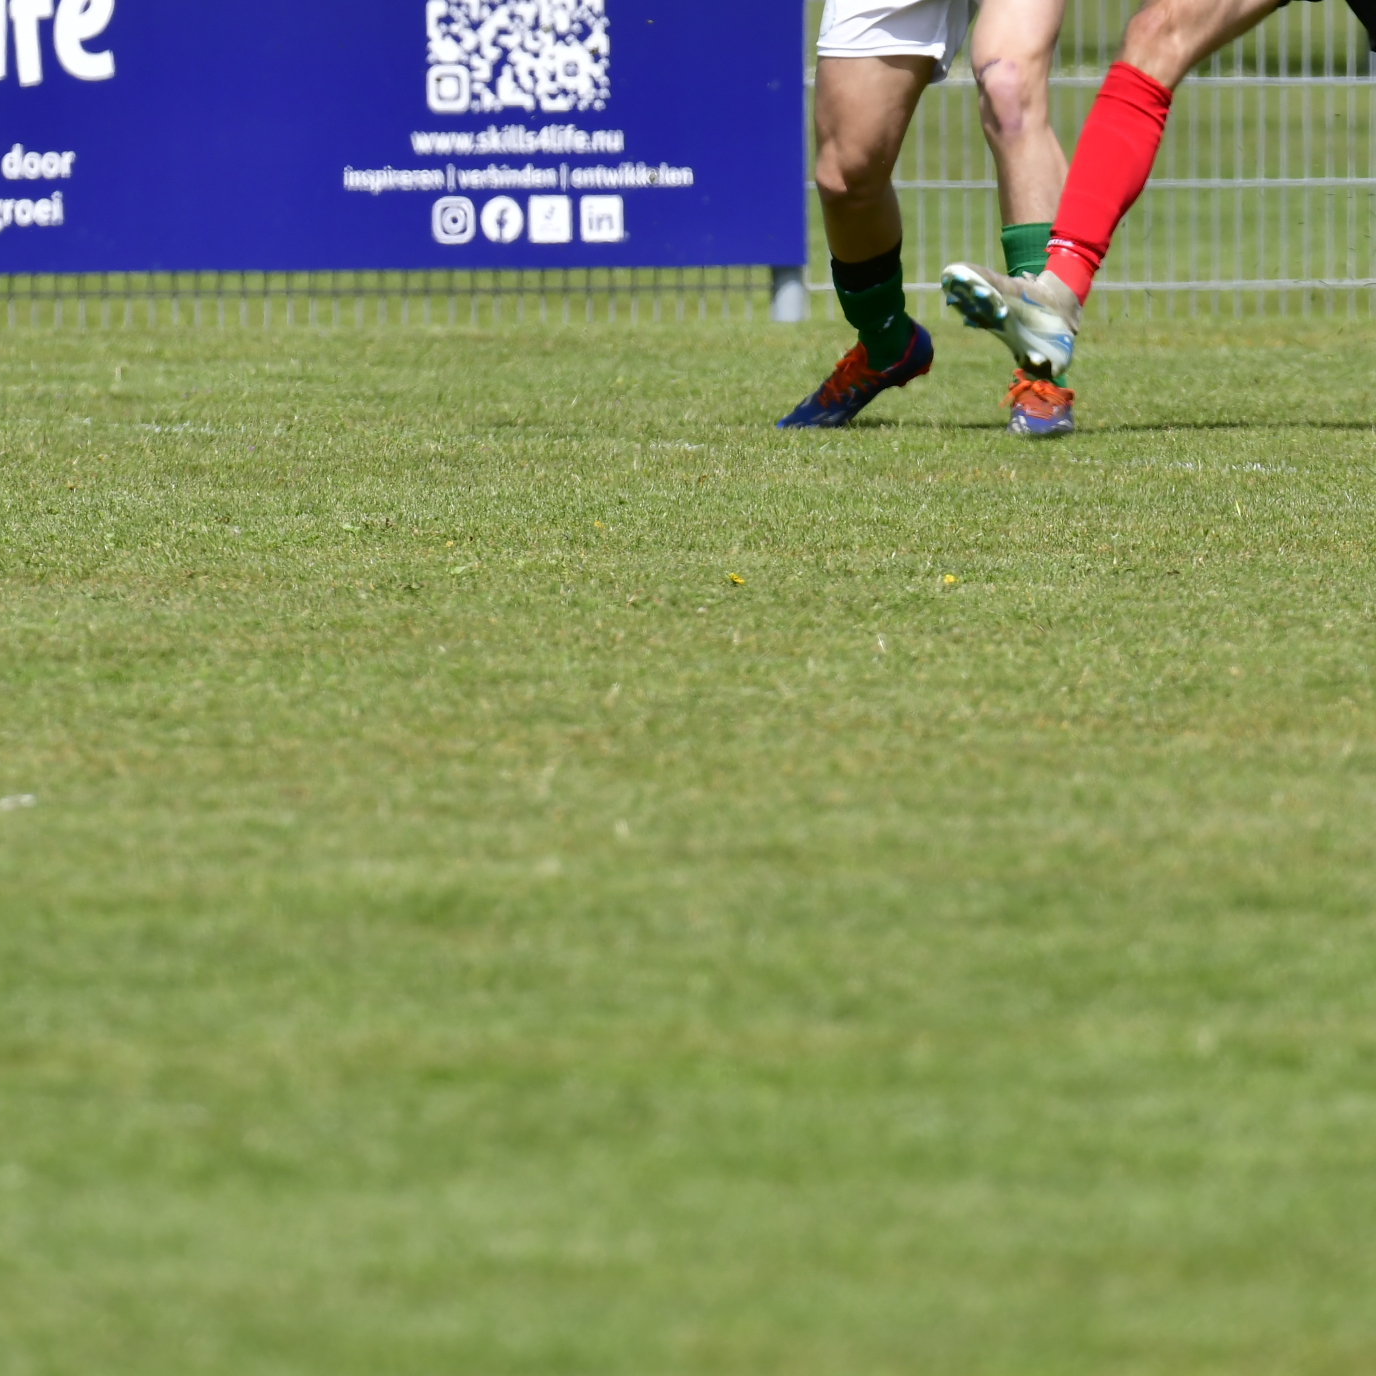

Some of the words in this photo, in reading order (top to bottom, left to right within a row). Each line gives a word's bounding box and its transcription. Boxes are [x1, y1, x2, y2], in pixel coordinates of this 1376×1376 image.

[410, 124, 624, 155] www.skills4life.nu
[1, 142, 76, 180] door
[343, 165, 445, 195] inspireren
[458, 163, 559, 190] verbinden
